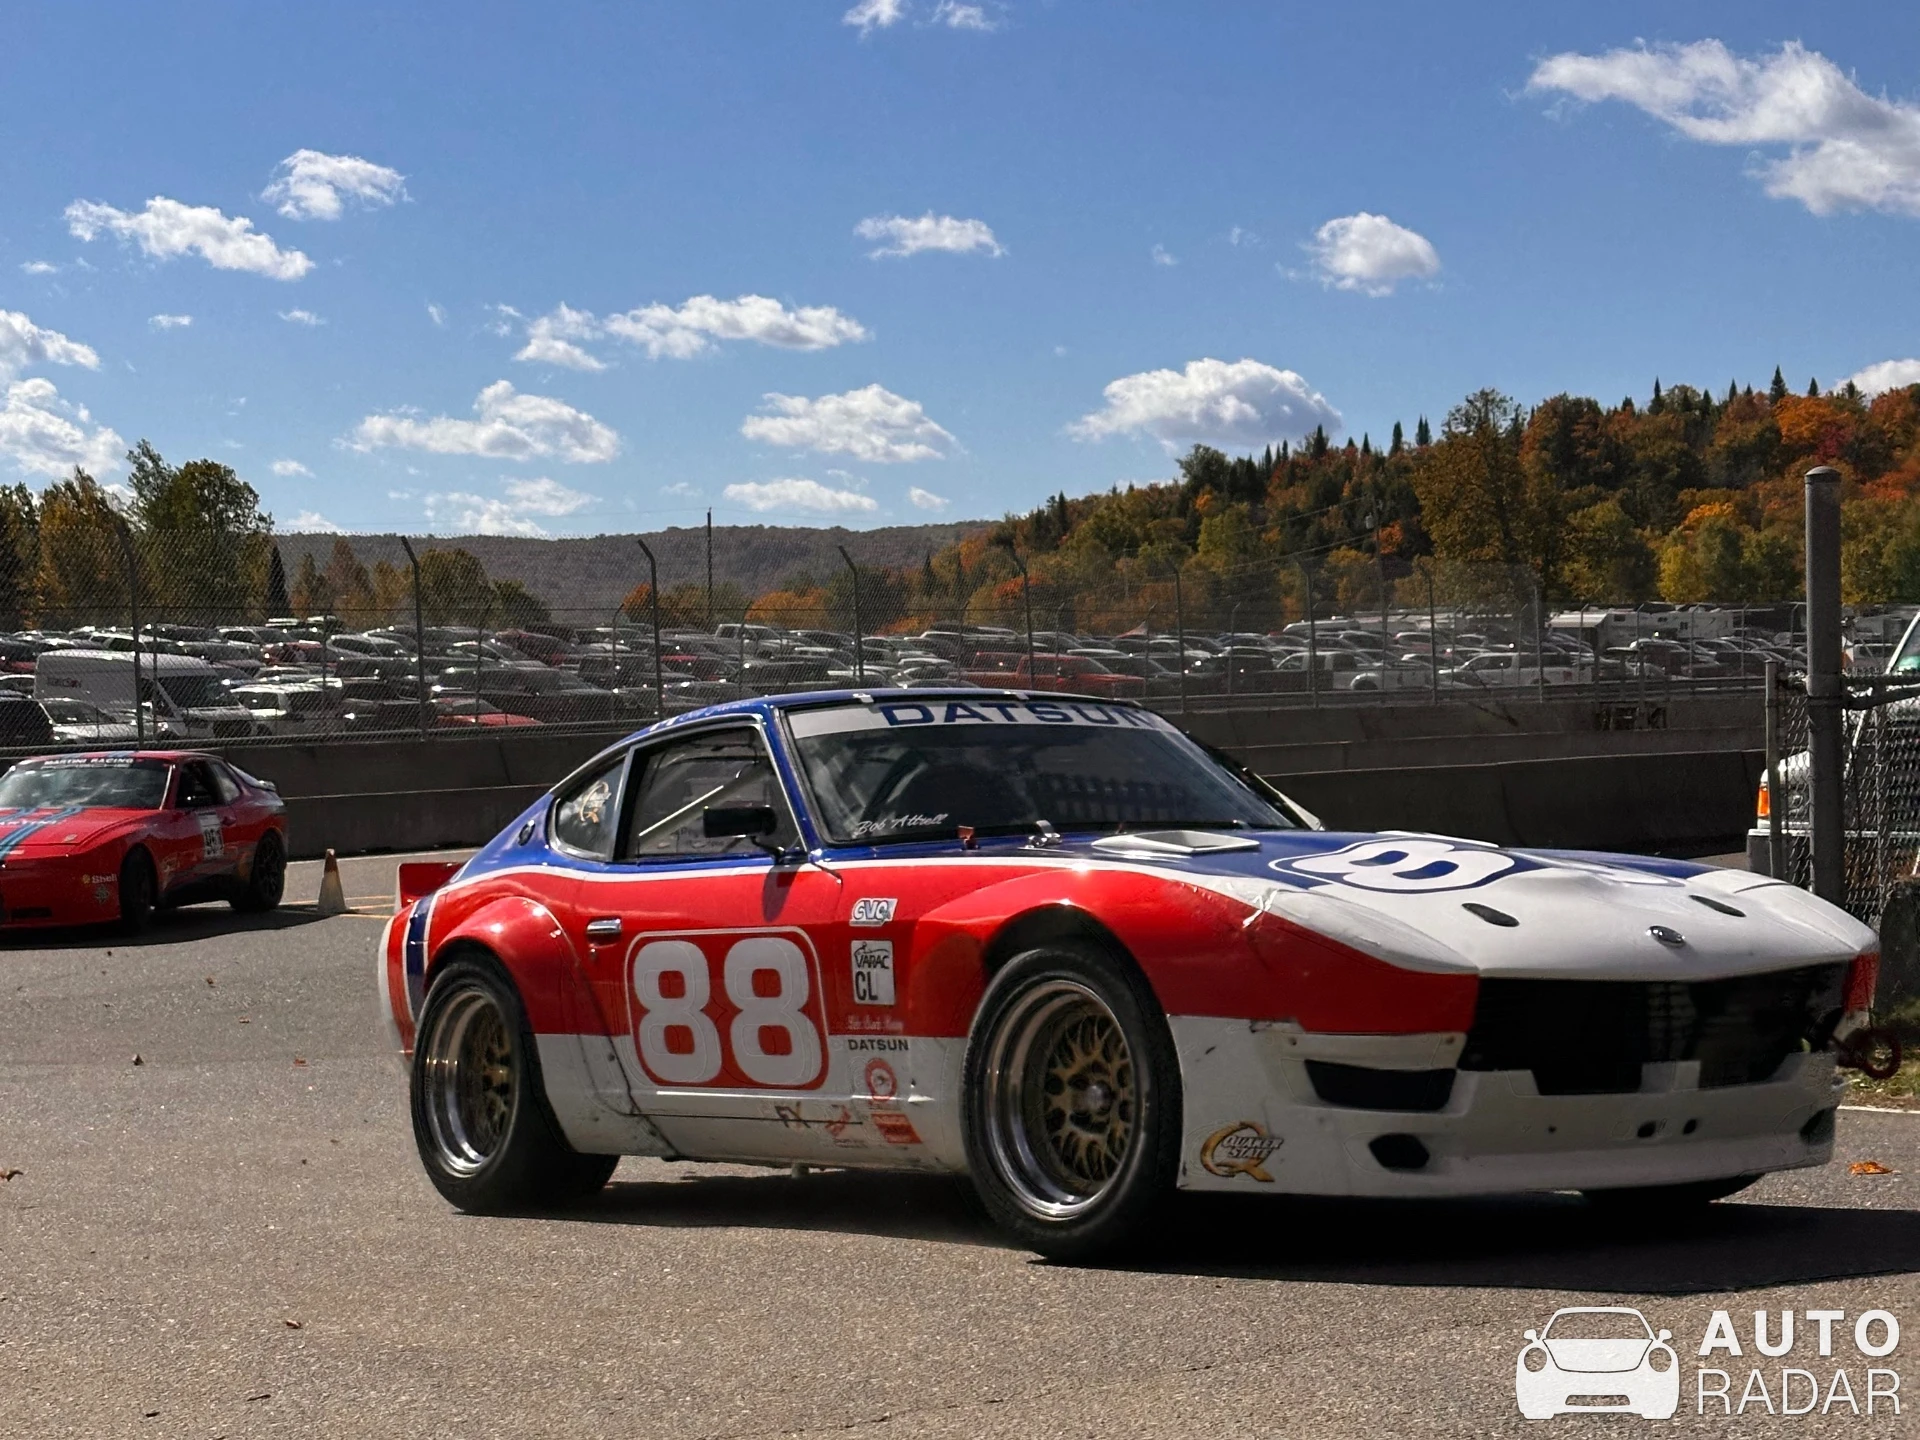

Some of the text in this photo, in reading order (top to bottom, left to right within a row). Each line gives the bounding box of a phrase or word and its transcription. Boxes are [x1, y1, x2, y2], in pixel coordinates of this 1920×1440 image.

[879, 702, 1157, 727] DATSUN
[857, 820, 887, 835] Bob
[92, 874, 118, 883] Shell
[855, 971, 878, 1001] CL
[633, 937, 822, 1086] 88
[848, 1039, 909, 1051] DATSUN
